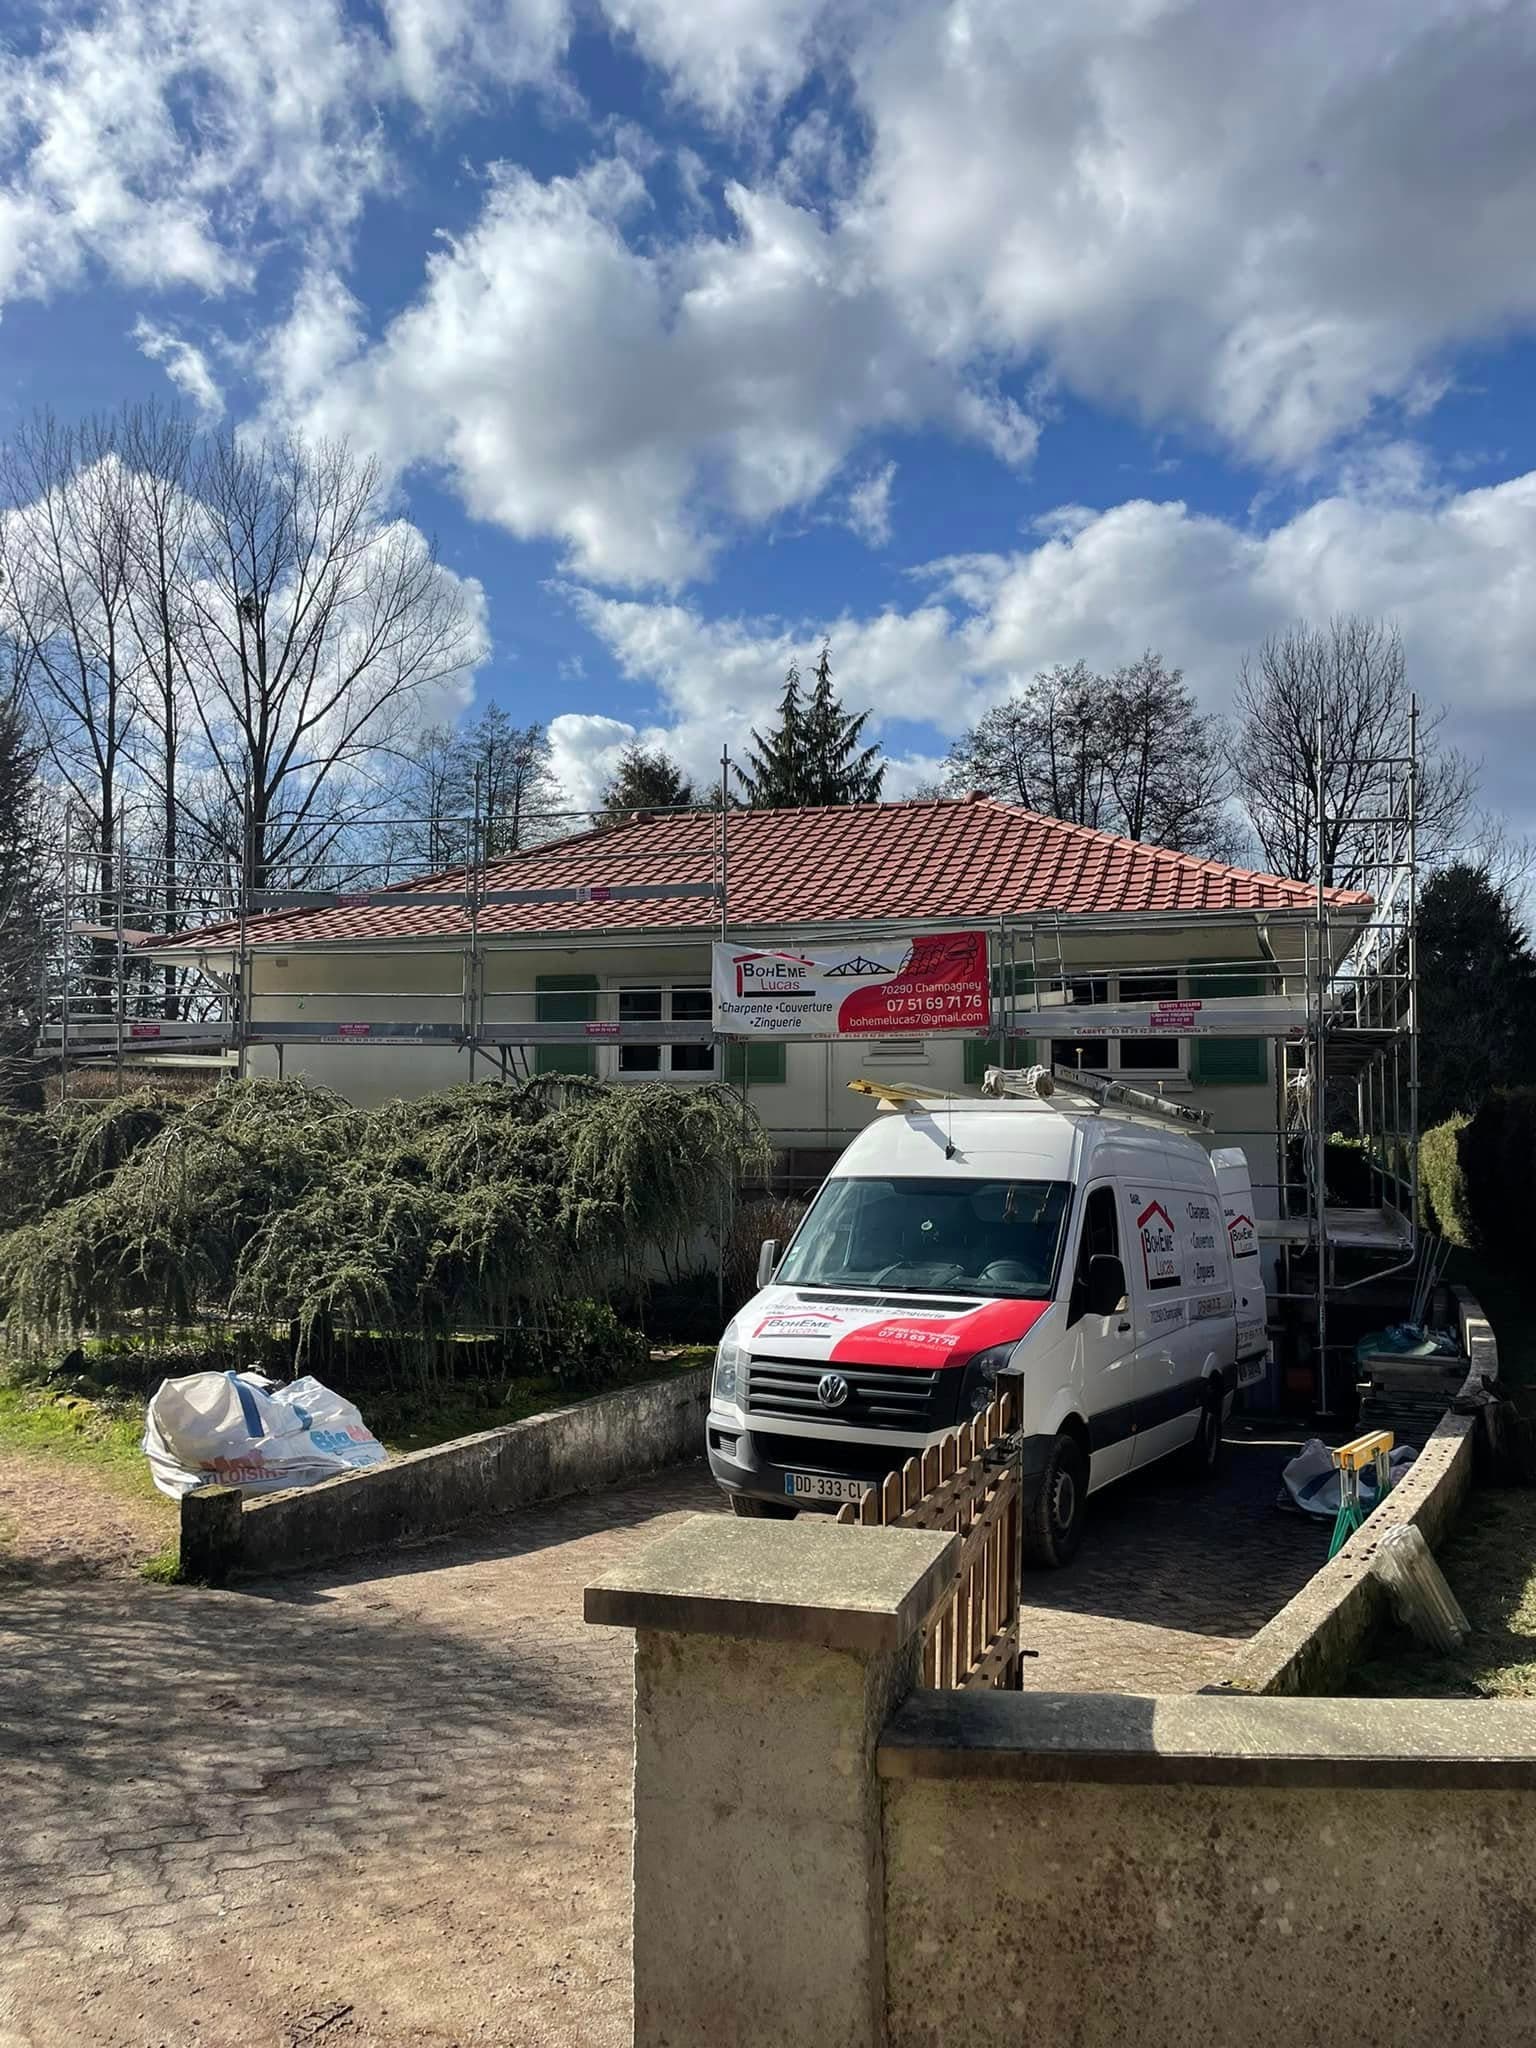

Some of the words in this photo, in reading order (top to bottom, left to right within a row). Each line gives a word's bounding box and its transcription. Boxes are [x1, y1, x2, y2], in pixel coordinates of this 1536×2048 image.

[761, 978, 800, 990] Lucas
[881, 984, 913, 995] 70290
[915, 981, 982, 994] Champagney
[887, 1000, 903, 1012] 07
[908, 998, 922, 1011] 51
[926, 997, 944, 1010] 69
[946, 996, 960, 1009] 71
[964, 995, 982, 1008] 76
[849, 1012, 983, 1027] bohemelucas7@gmail.com
[910, 1333, 926, 1341] 69
[928, 1335, 941, 1344] 71
[942, 1337, 957, 1346] 76
[796, 1476, 862, 1498] DD-333-CL
